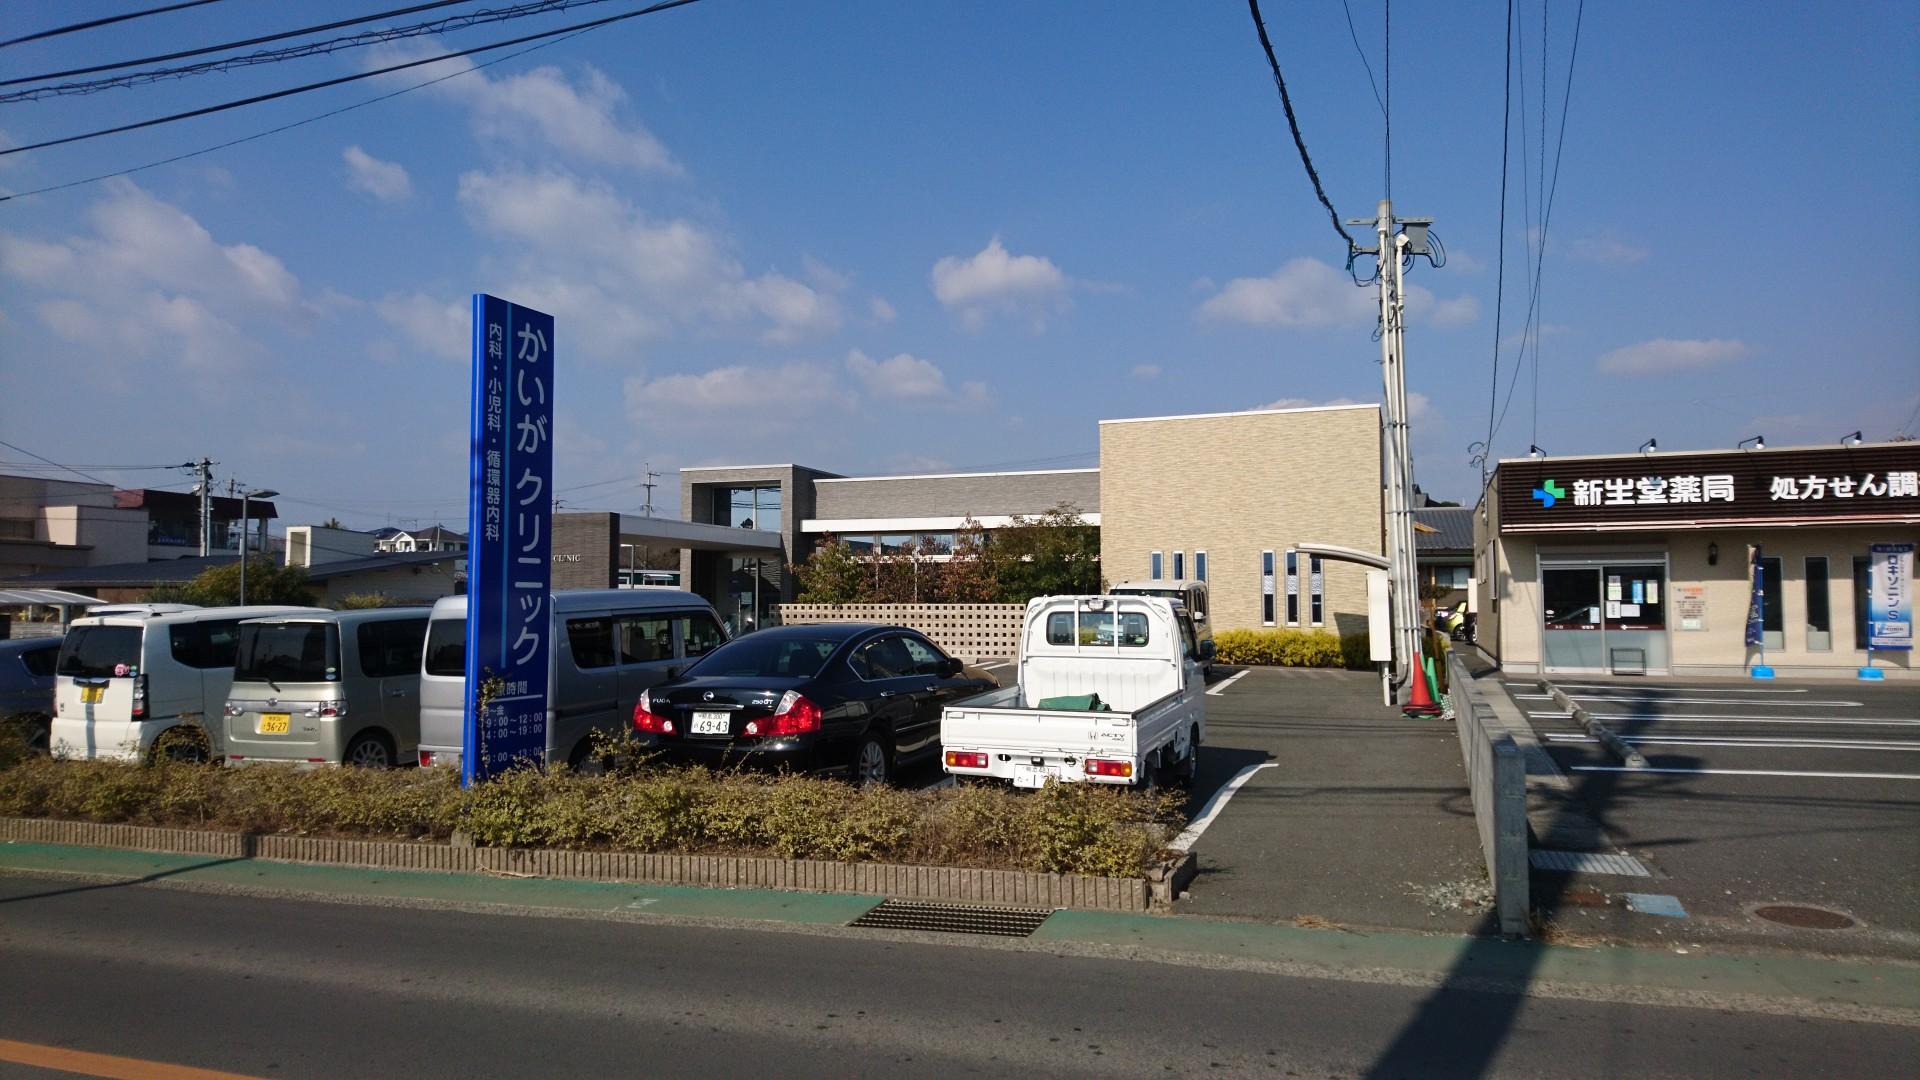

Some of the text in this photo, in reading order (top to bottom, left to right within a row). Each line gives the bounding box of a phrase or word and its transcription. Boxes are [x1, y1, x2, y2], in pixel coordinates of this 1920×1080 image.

[485, 323, 503, 542] 内科・小児科・循環器内科
[1572, 471, 1920, 506] 新生堂薬局 処方せん調
[699, 720, 728, 732] 69-43
